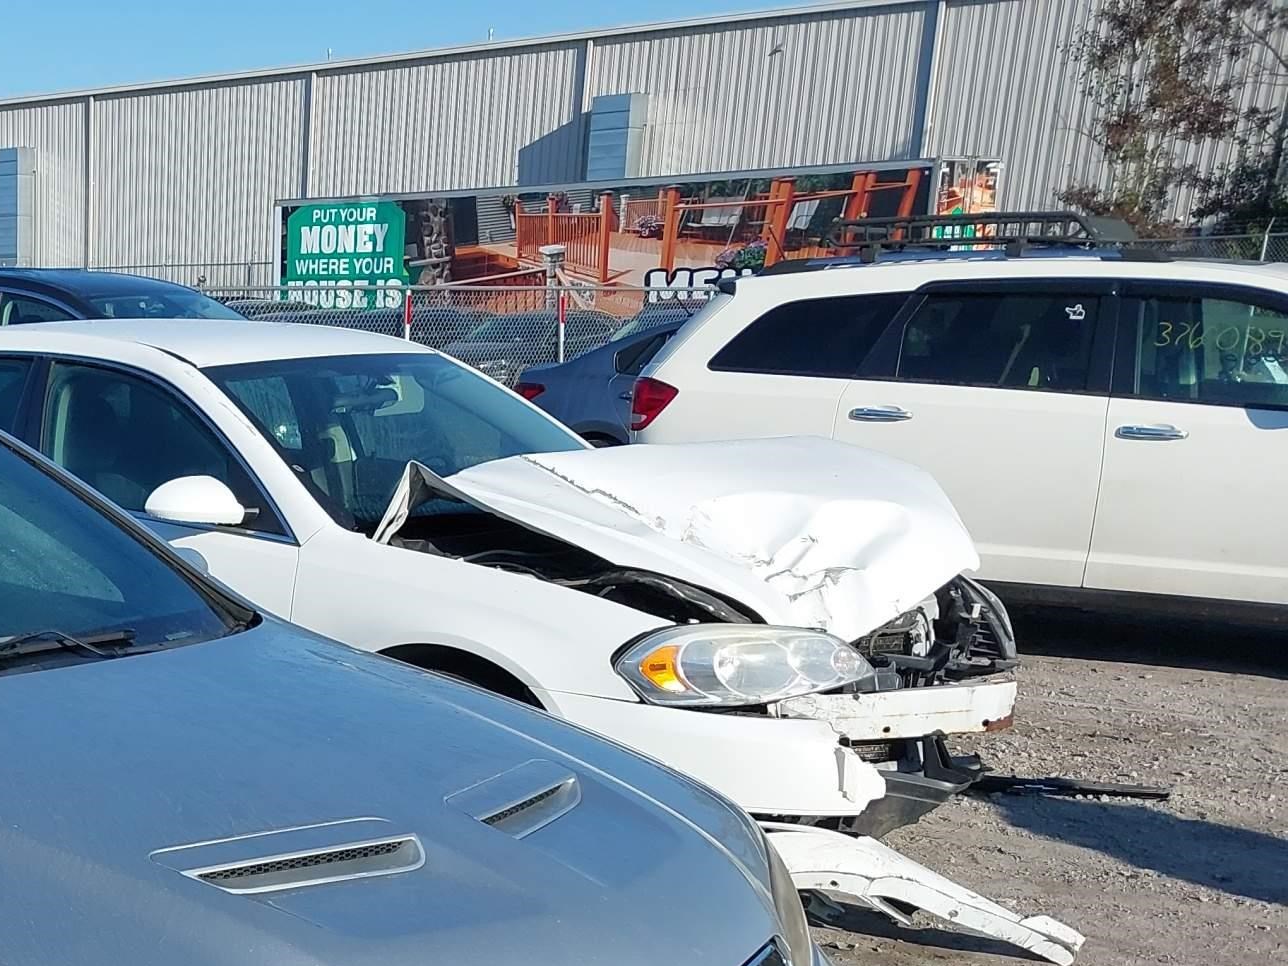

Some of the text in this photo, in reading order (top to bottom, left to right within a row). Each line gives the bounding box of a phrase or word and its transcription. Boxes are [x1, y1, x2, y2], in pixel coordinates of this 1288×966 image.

[312, 207, 377, 223] PUT YOUR
[300, 223, 389, 254] MONEY
[295, 257, 394, 276] WHERE YOUR
[287, 279, 402, 309] HOUSE IS
